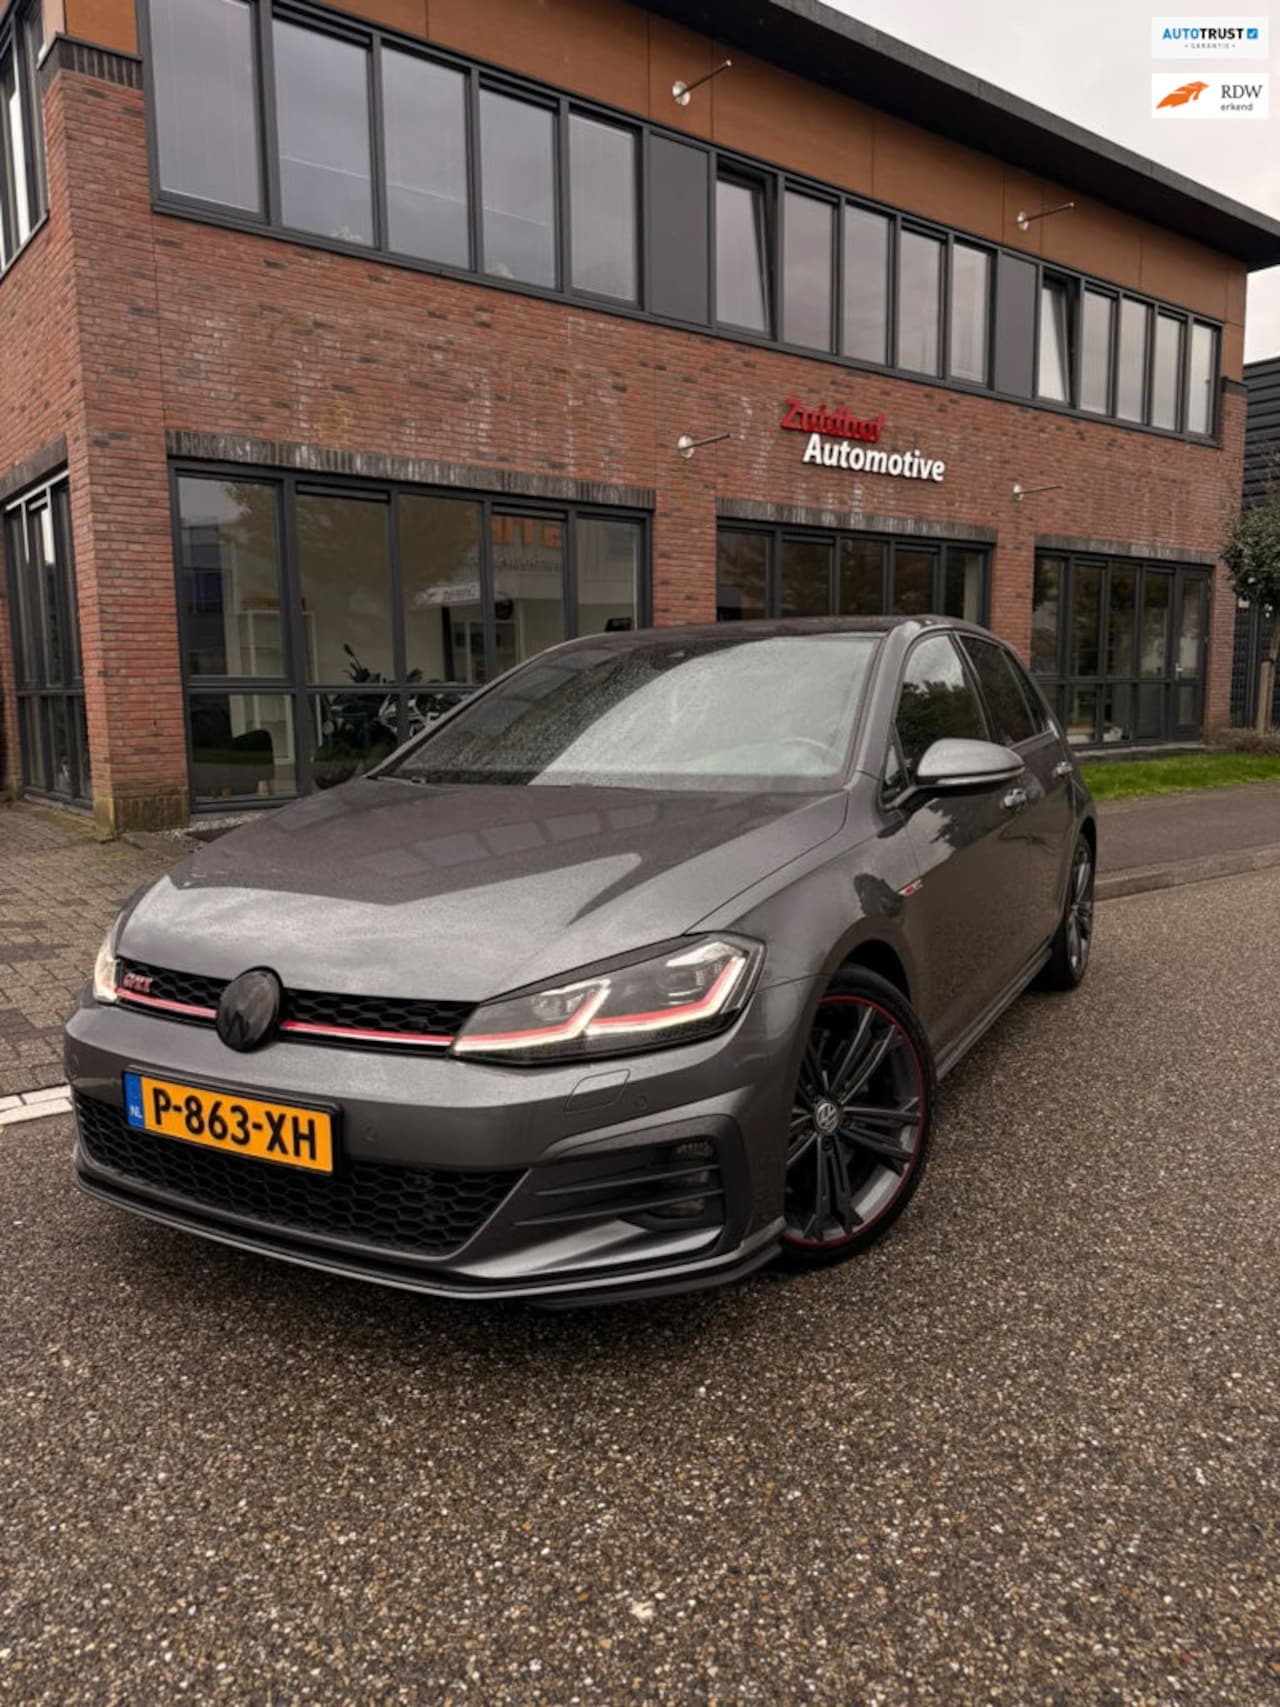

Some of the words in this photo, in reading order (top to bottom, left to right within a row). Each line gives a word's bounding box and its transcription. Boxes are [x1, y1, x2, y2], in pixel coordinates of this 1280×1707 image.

[803, 432, 946, 482] Automotive
[129, 1104, 143, 1120] NL
[151, 1086, 318, 1161] P-863-XH
